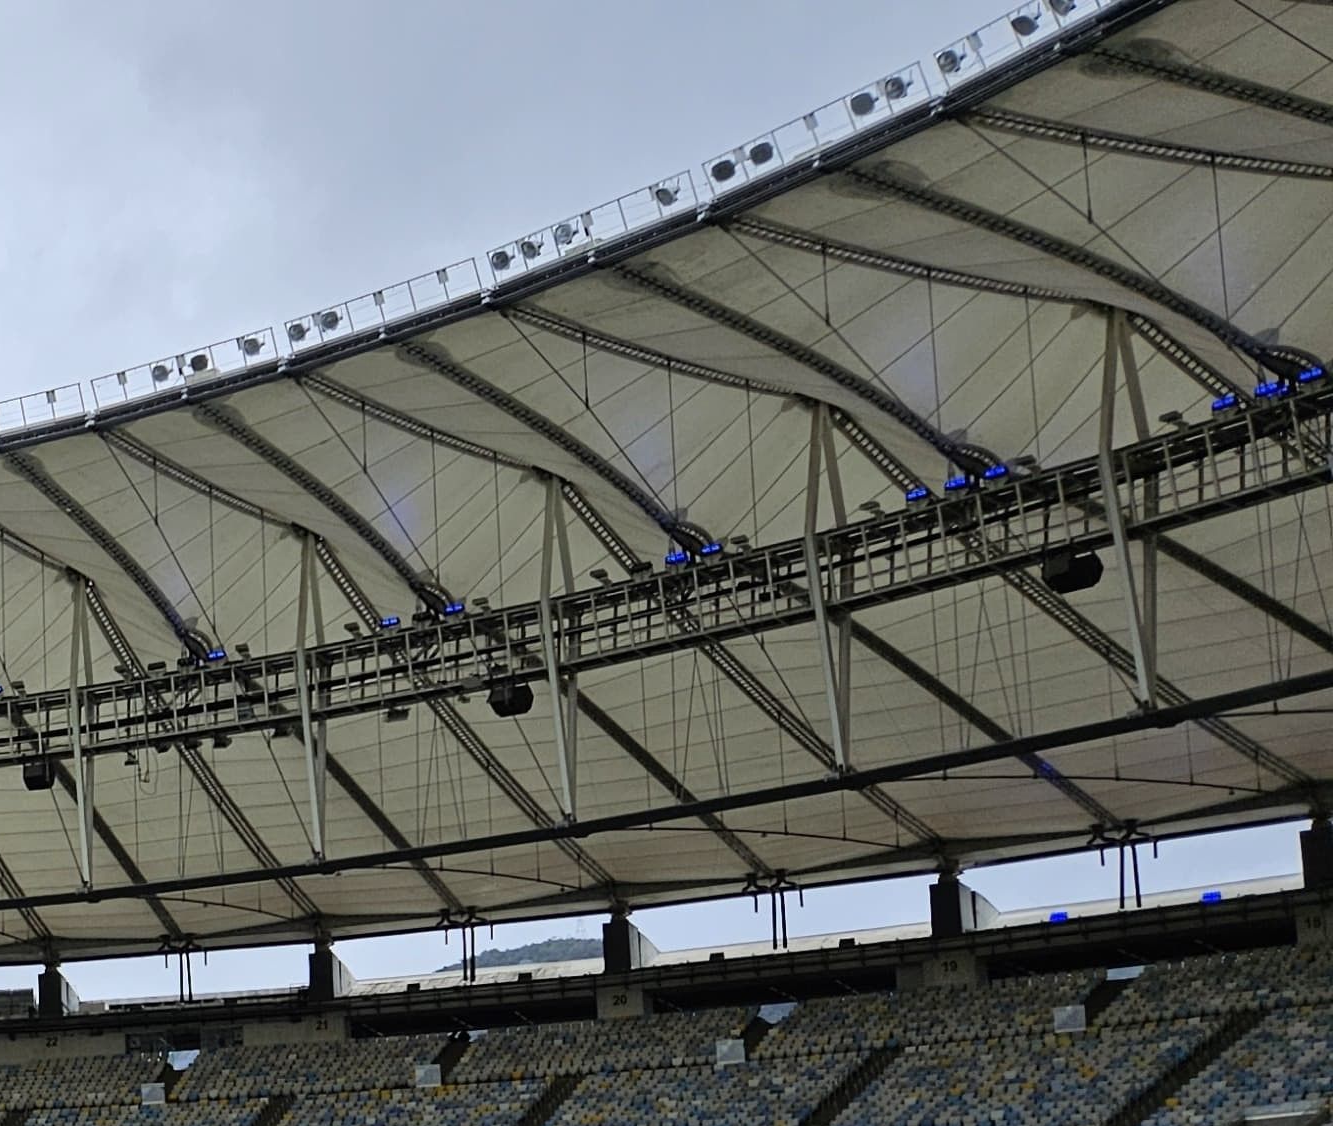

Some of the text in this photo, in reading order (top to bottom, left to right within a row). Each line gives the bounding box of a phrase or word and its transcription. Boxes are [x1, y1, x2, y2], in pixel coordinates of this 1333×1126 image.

[612, 994, 628, 1007] 20
[315, 1019, 329, 1031] 21
[45, 1037, 59, 1048] 22
